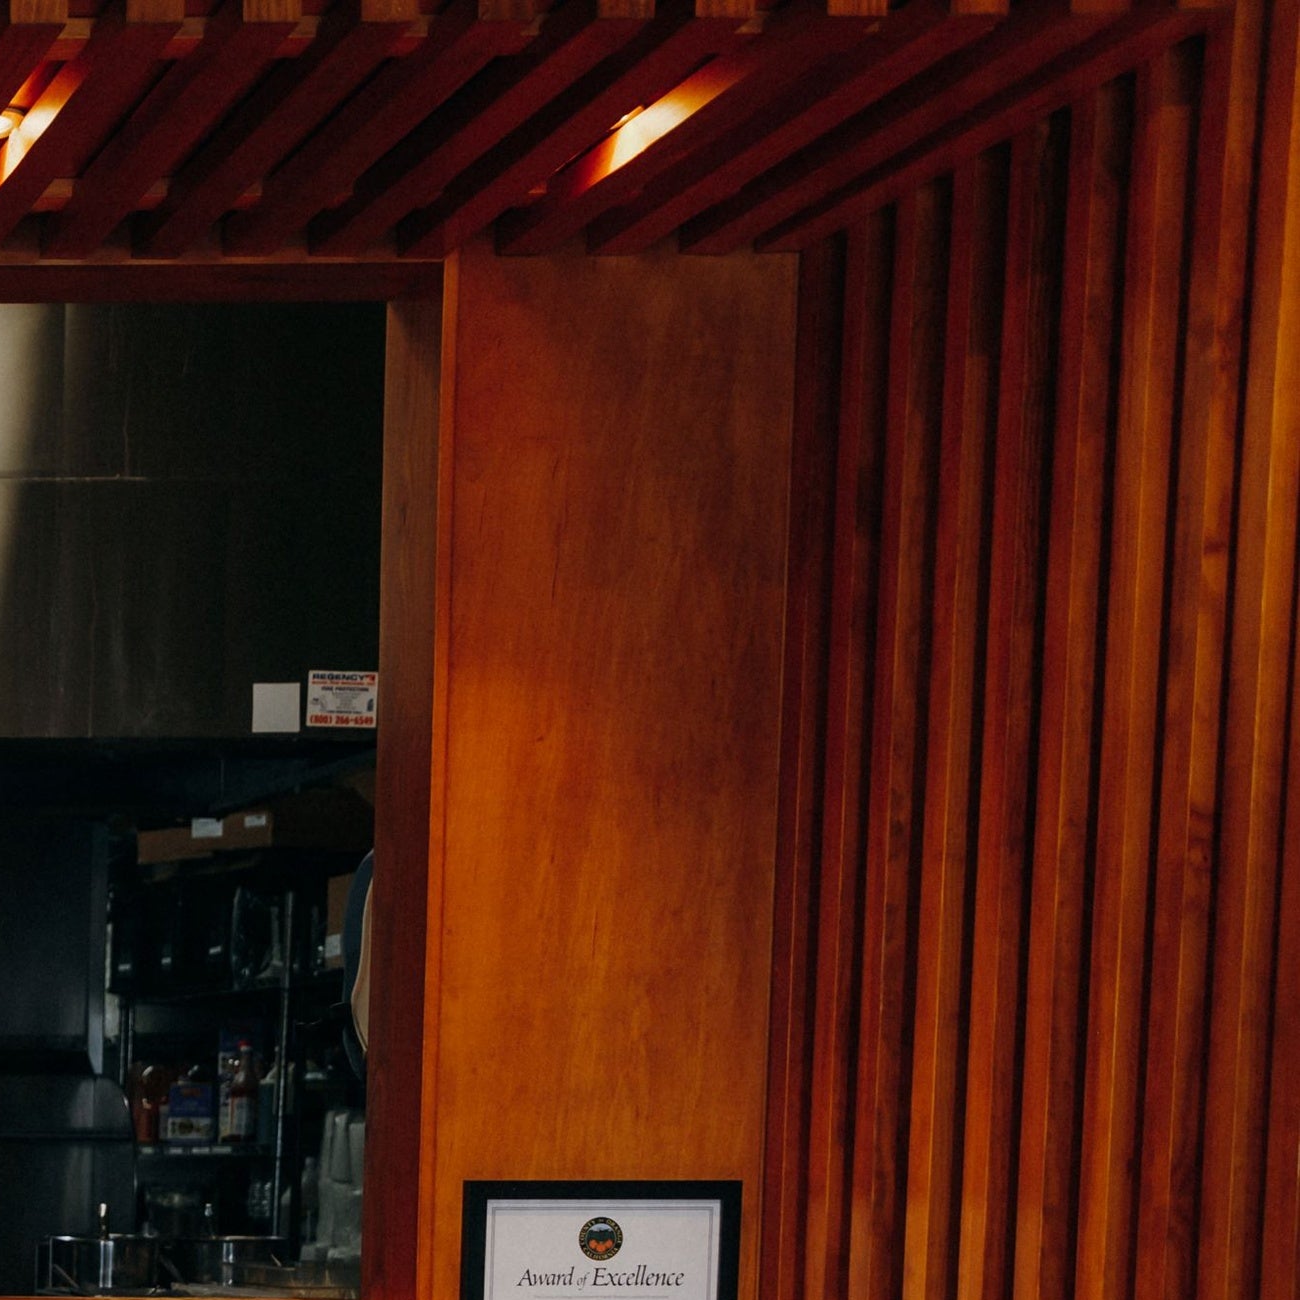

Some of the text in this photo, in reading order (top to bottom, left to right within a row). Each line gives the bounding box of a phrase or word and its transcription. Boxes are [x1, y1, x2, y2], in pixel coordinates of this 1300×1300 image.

[310, 715, 332, 724] (800)
[517, 1264, 685, 1290] Award of Excellence
